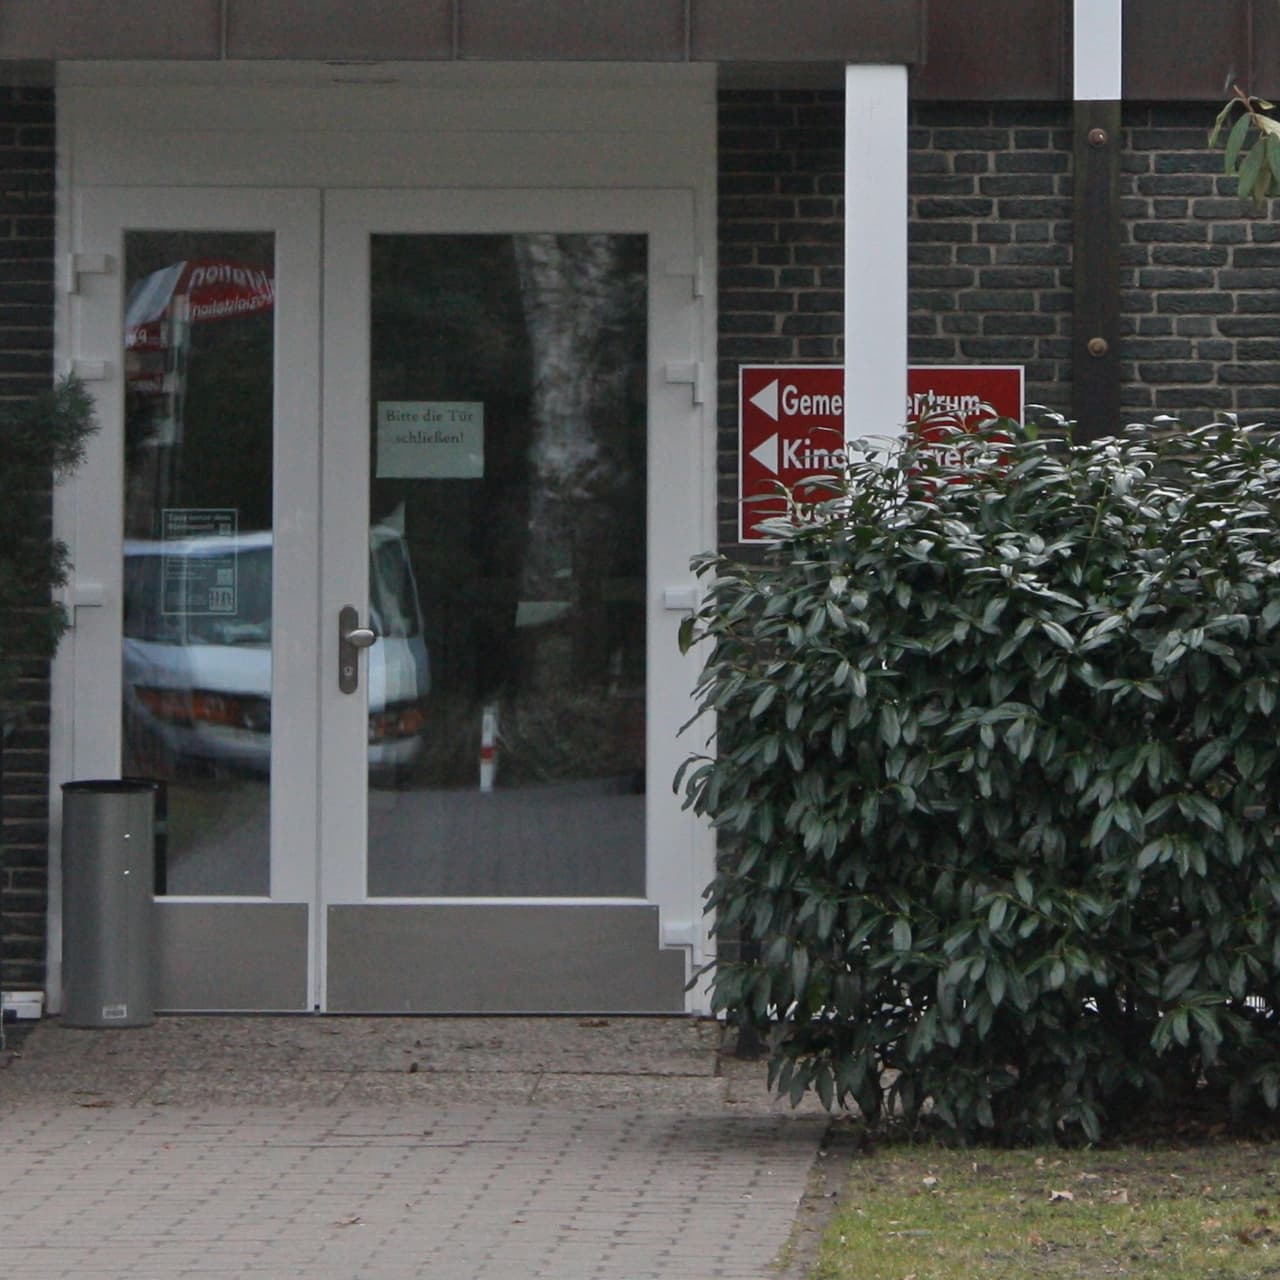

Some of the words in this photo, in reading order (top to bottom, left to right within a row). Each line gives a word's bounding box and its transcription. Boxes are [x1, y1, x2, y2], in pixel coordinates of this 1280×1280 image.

[386, 409, 418, 422] Bitte
[423, 408, 443, 422] die
[448, 409, 473, 422] Tür
[395, 430, 464, 444] schließen!
